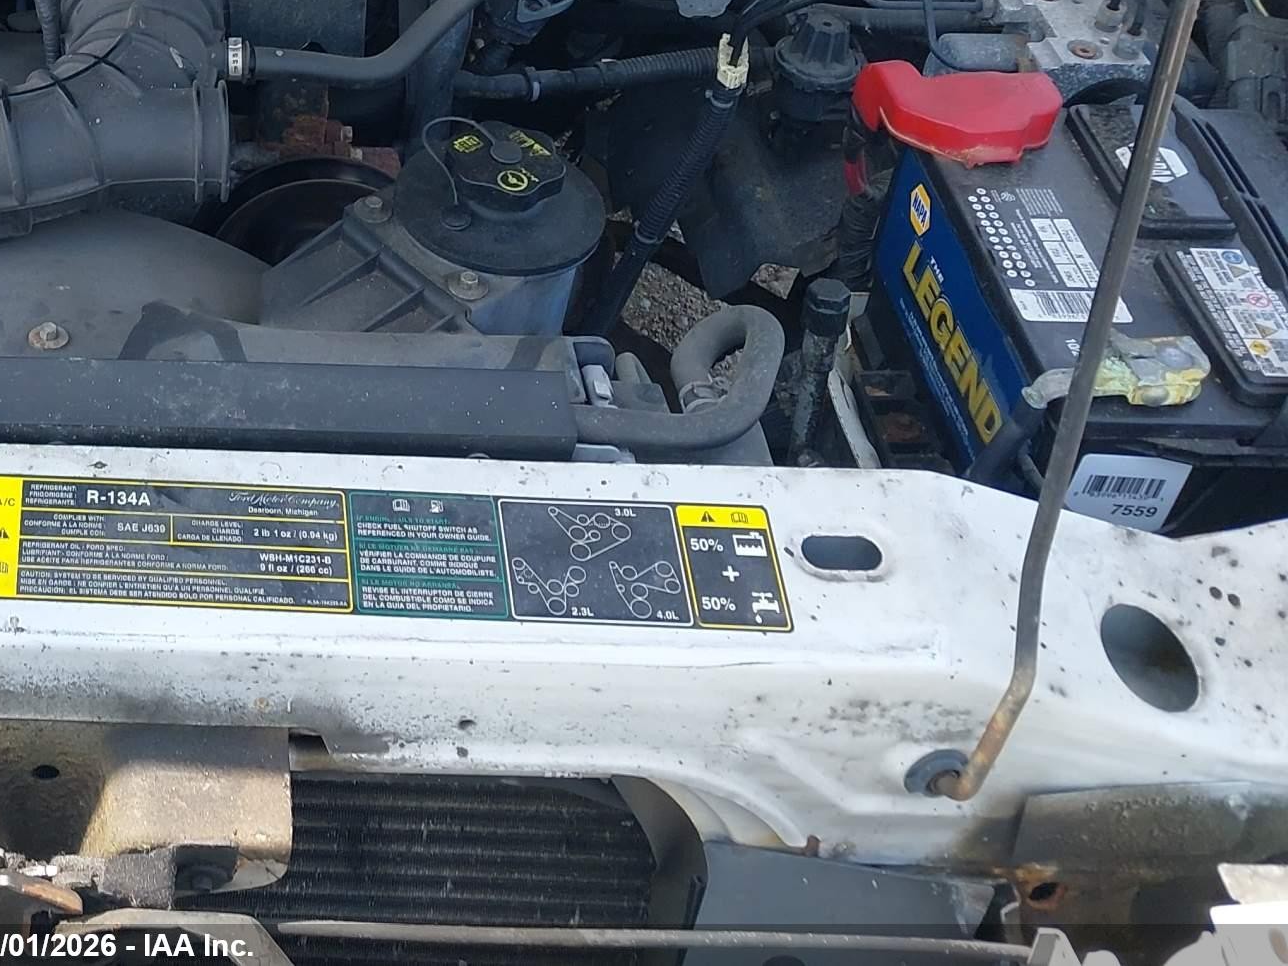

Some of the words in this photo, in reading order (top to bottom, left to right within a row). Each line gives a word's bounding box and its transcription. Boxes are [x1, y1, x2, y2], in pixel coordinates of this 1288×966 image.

[911, 191, 929, 228] NAPA
[929, 255, 945, 284] THE
[902, 239, 1003, 445] LEGEND
[86, 489, 151, 506] R-134A
[614, 508, 636, 517] 3.0L
[1110, 503, 1159, 518] 7559
[117, 521, 138, 531] SAE
[437, 525, 466, 533] SWITCH
[253, 528, 259, 536] 2
[261, 528, 270, 537] lb
[279, 530, 291, 538] oz
[690, 538, 724, 552] 50%
[276, 564, 287, 572] oz
[701, 596, 736, 611] 50%
[572, 607, 594, 617] 2.3L
[656, 609, 679, 620] 4.0L
